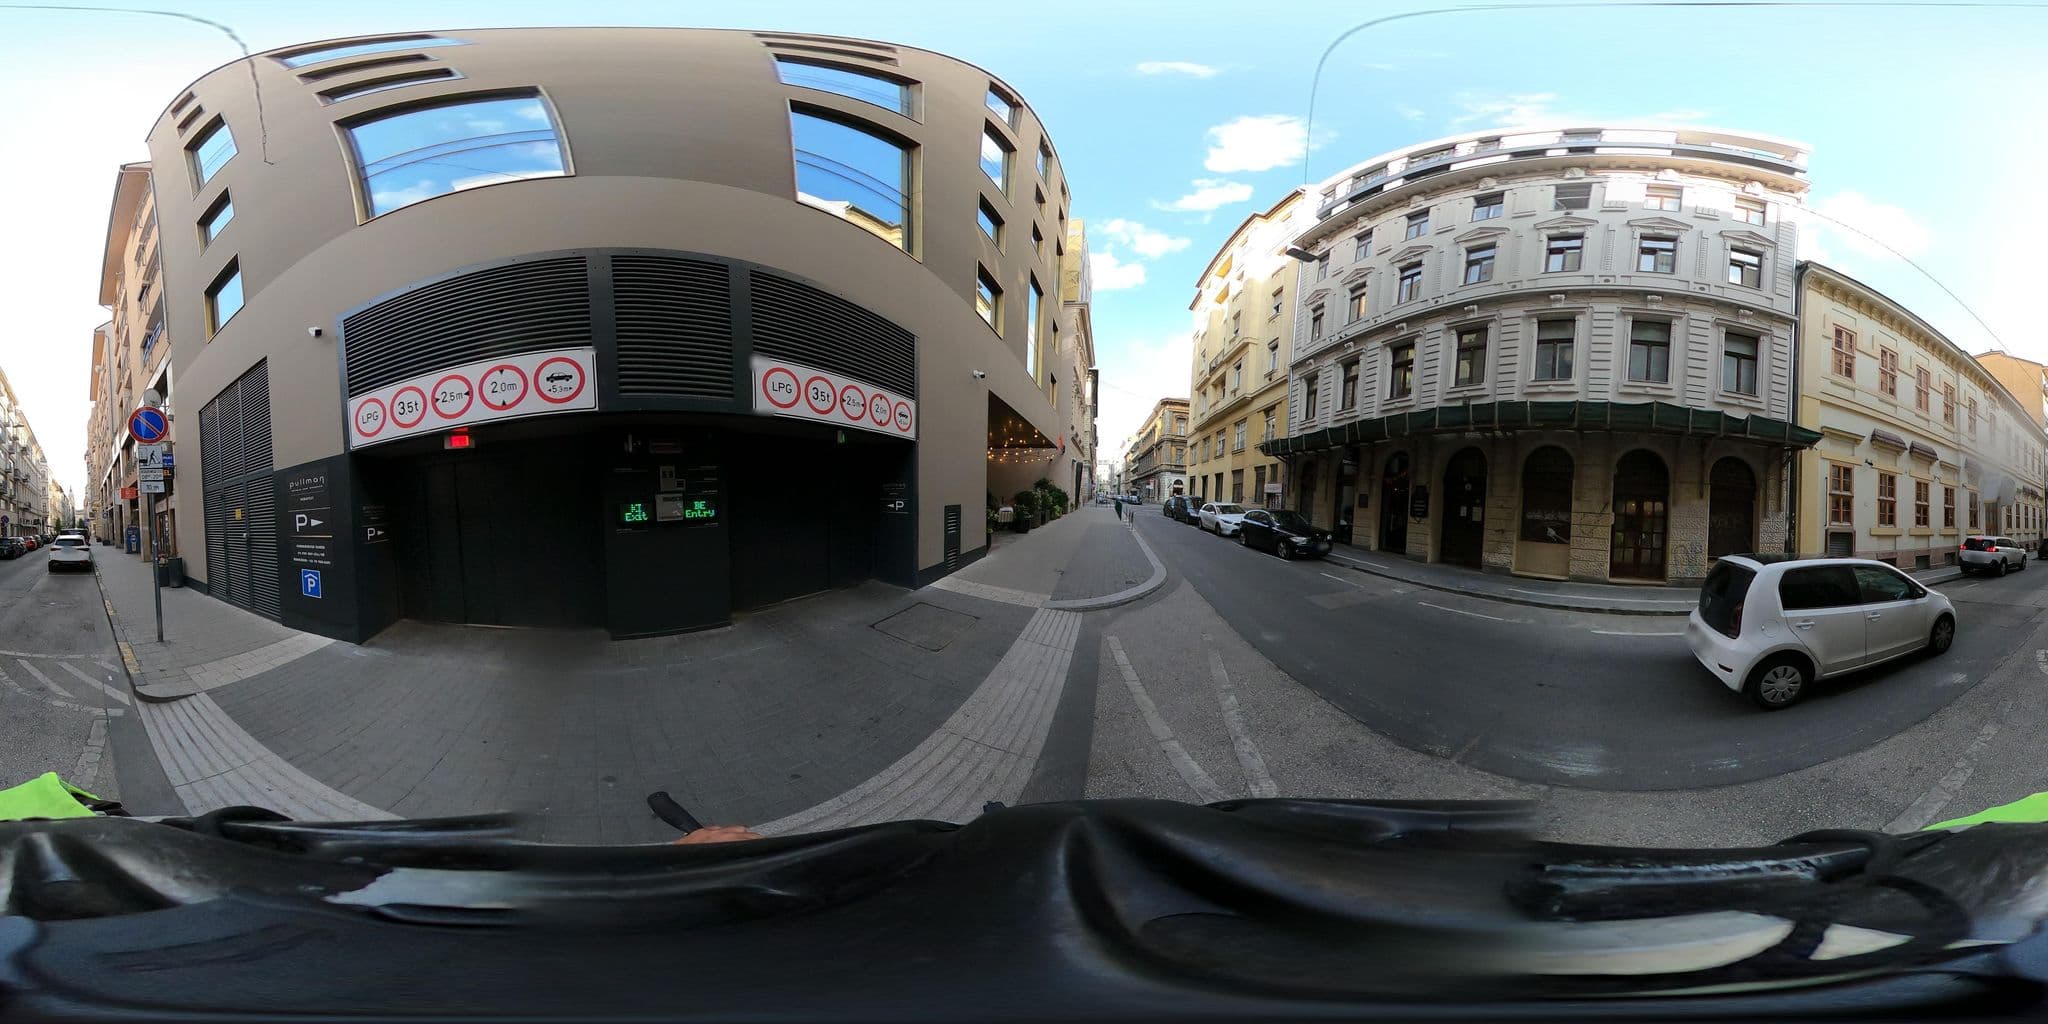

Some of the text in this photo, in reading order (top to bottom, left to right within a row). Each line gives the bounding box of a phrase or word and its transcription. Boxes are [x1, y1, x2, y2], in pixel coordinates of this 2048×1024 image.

[771, 381, 793, 394] LPG
[361, 411, 379, 424] LPG
[694, 501, 706, 509] BE
[895, 500, 905, 511] P
[625, 512, 648, 521] Exit
[685, 509, 715, 518] Entry
[296, 514, 308, 532] P
[367, 527, 376, 540] P
